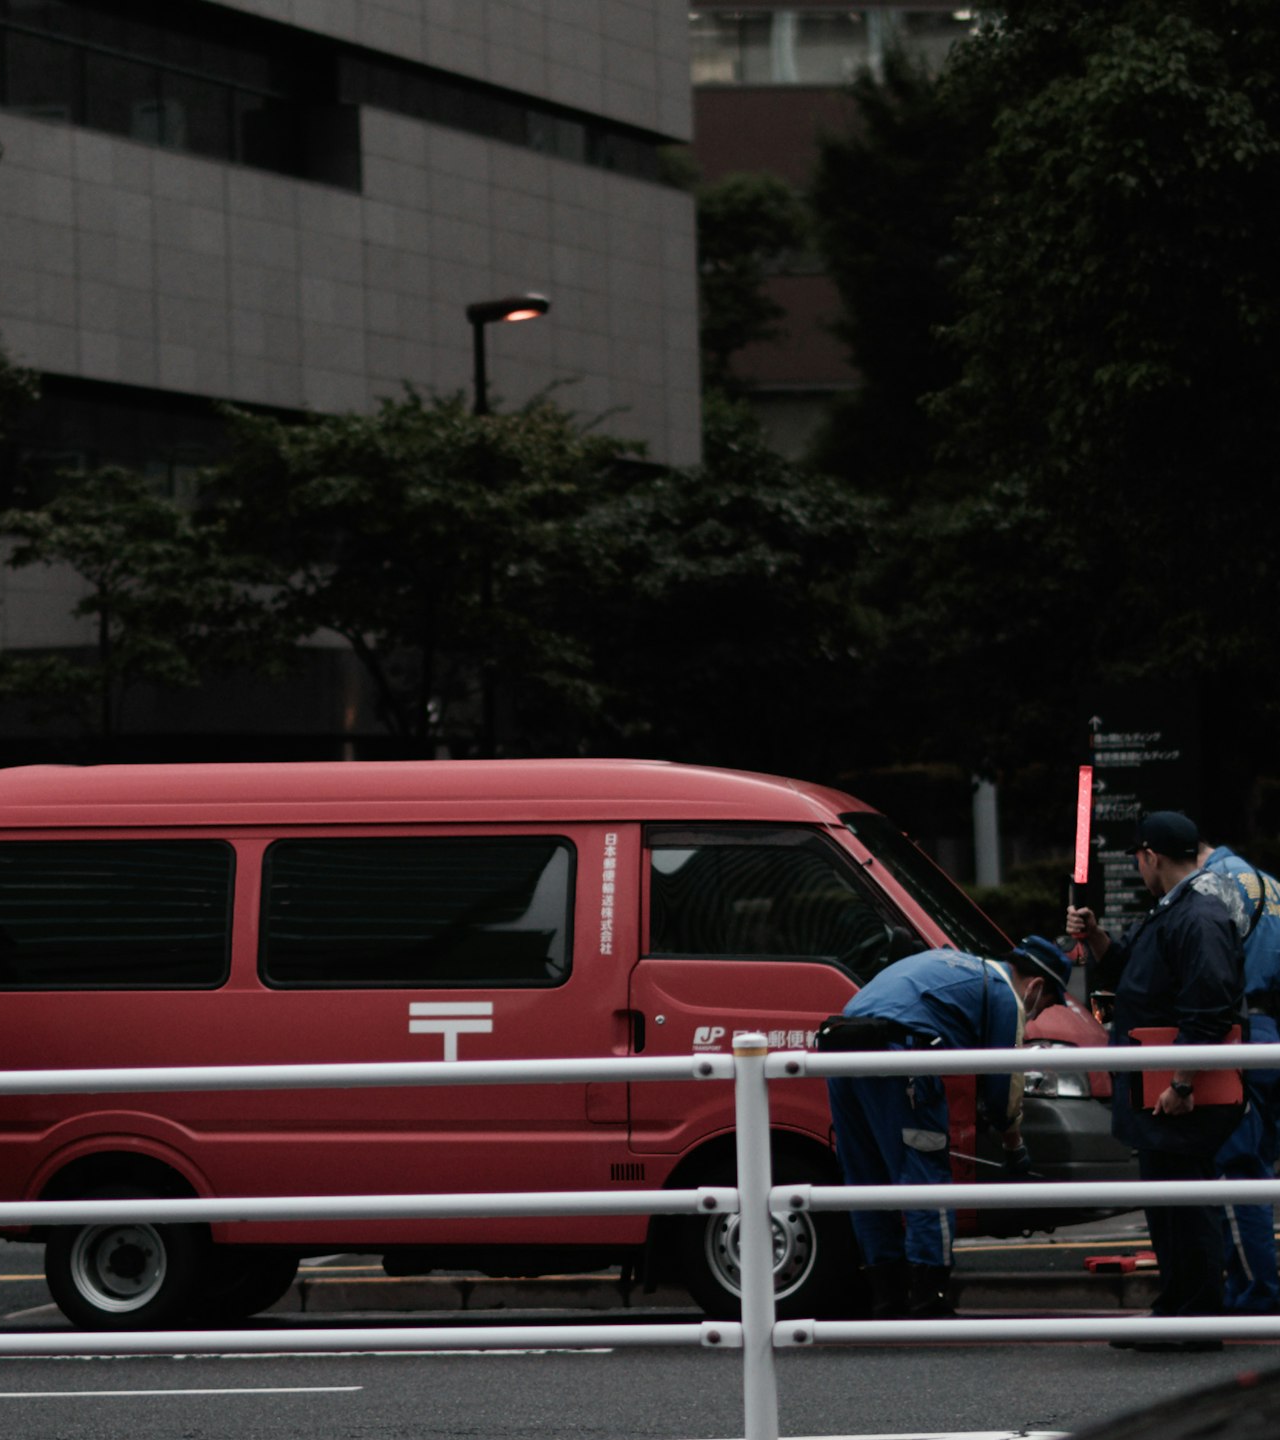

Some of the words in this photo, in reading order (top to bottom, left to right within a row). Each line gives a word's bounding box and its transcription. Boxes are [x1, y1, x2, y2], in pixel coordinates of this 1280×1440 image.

[600, 832, 617, 955] 日本郵便輸送株式会社
